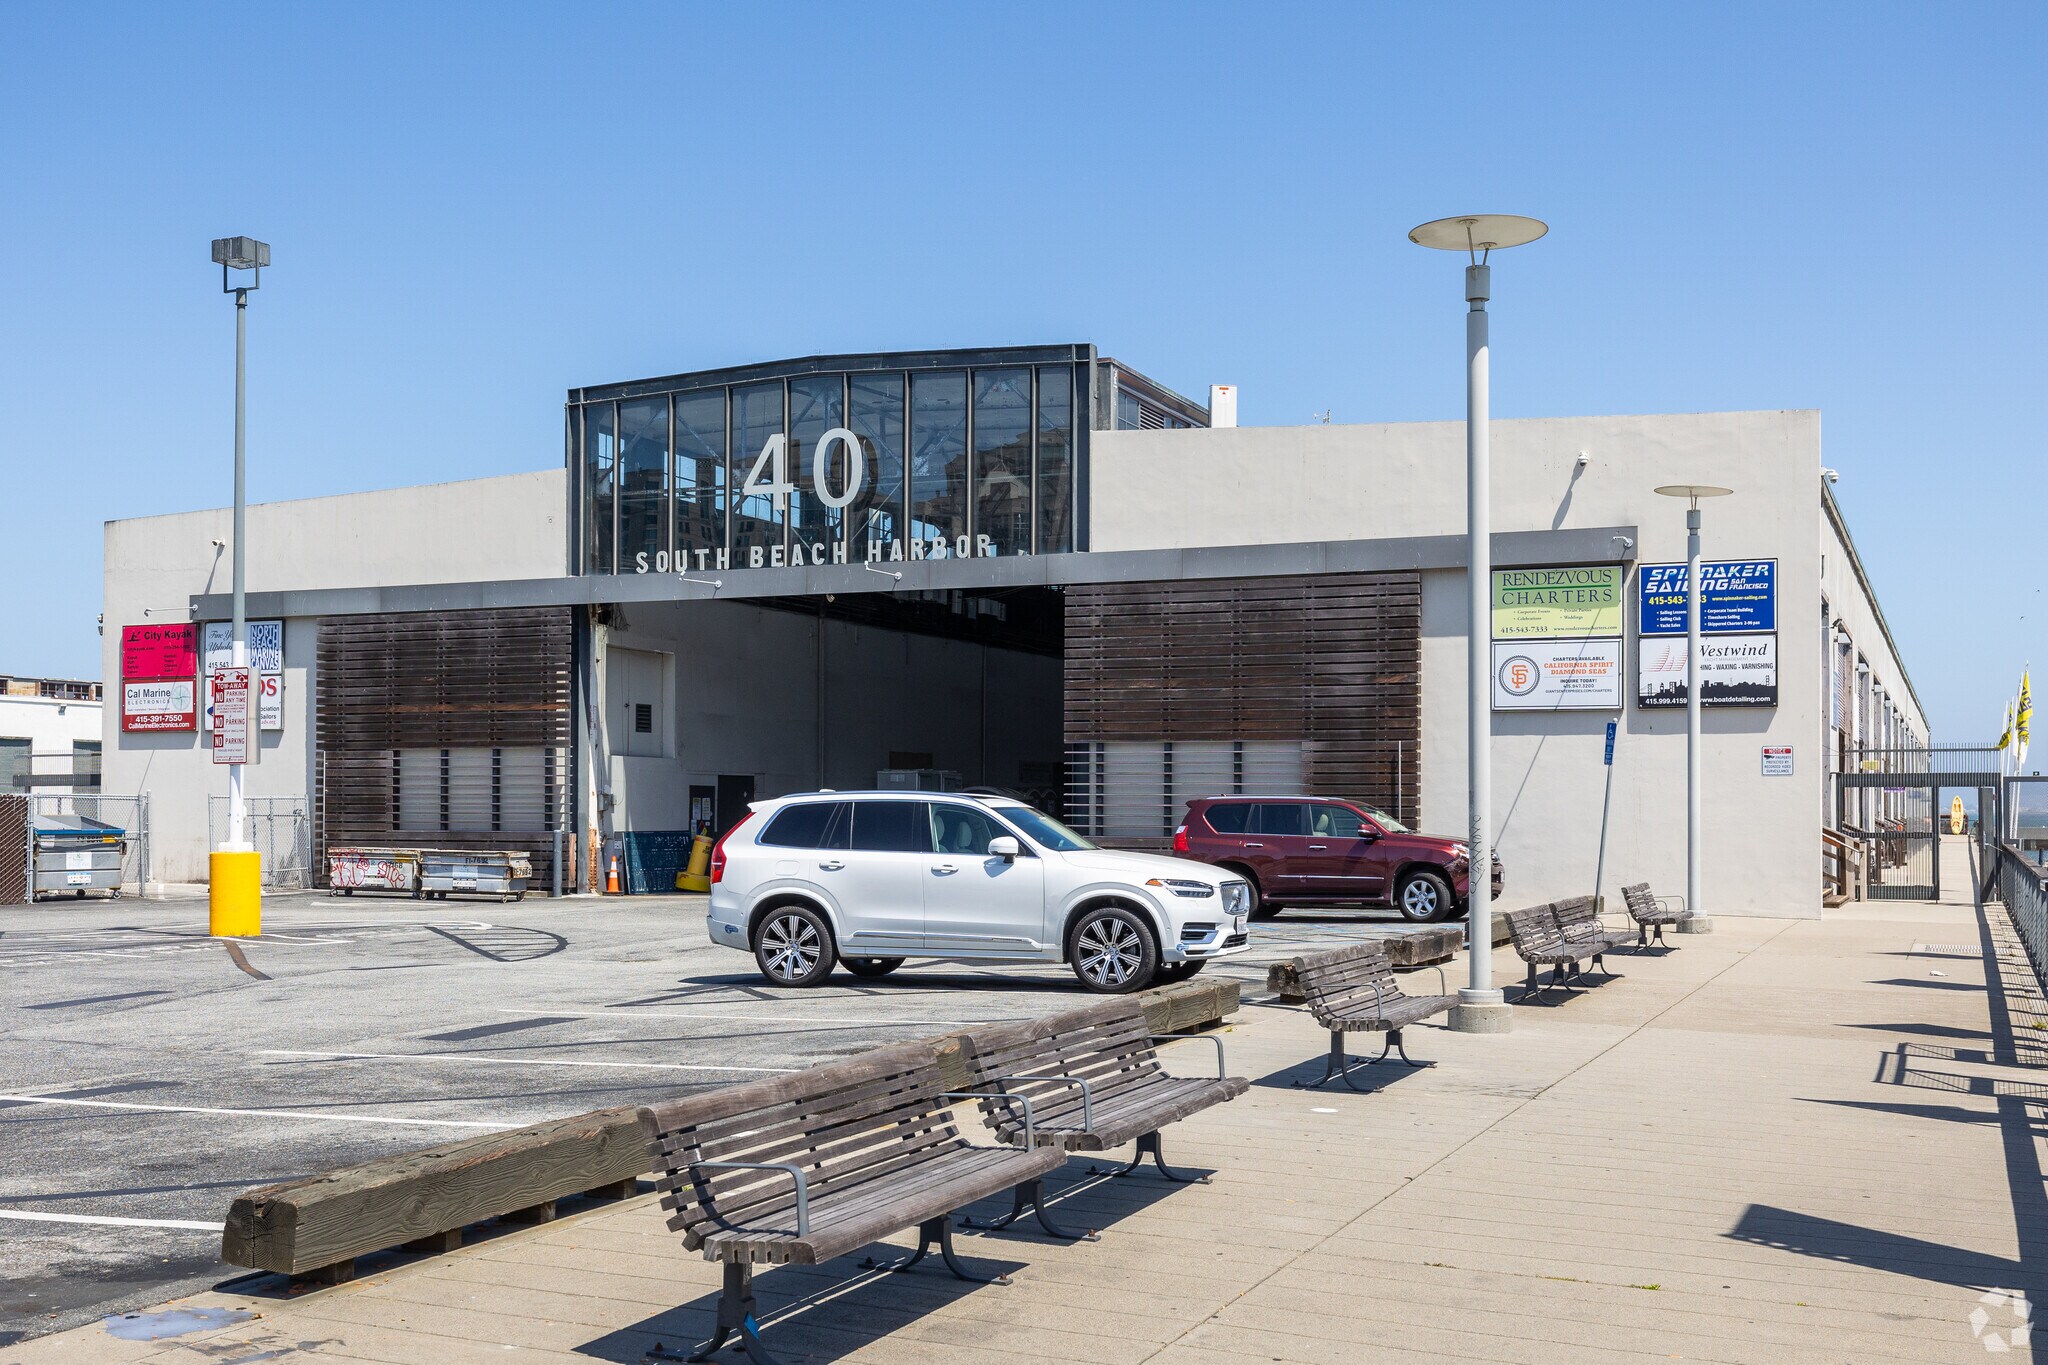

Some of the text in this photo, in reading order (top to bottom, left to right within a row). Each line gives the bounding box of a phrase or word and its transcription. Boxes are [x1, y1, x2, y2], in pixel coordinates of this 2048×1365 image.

[743, 428, 863, 511] 40
[635, 533, 991, 574] SOUTH BEACH HARBOR
[1502, 569, 1612, 587] RENDEZVOUS
[1502, 588, 1612, 605] CHARTERS
[144, 629, 192, 641] City Kayak
[251, 624, 279, 637] NORTH
[1500, 625, 1548, 634] 415-543-7333
[251, 635, 279, 648] BEACH
[251, 648, 279, 659] MARINE
[251, 658, 279, 670] CANVAS
[1716, 662, 1737, 670] WAXING
[1741, 662, 1774, 670] VARNISHING
[127, 688, 171, 699] Cal Marine
[215, 691, 224, 702] NO
[135, 714, 183, 723] 415-391-7550
[215, 717, 223, 728] NO
[128, 721, 190, 729] CalMarineElectronics.com
[215, 736, 245, 747] NO PARKING
